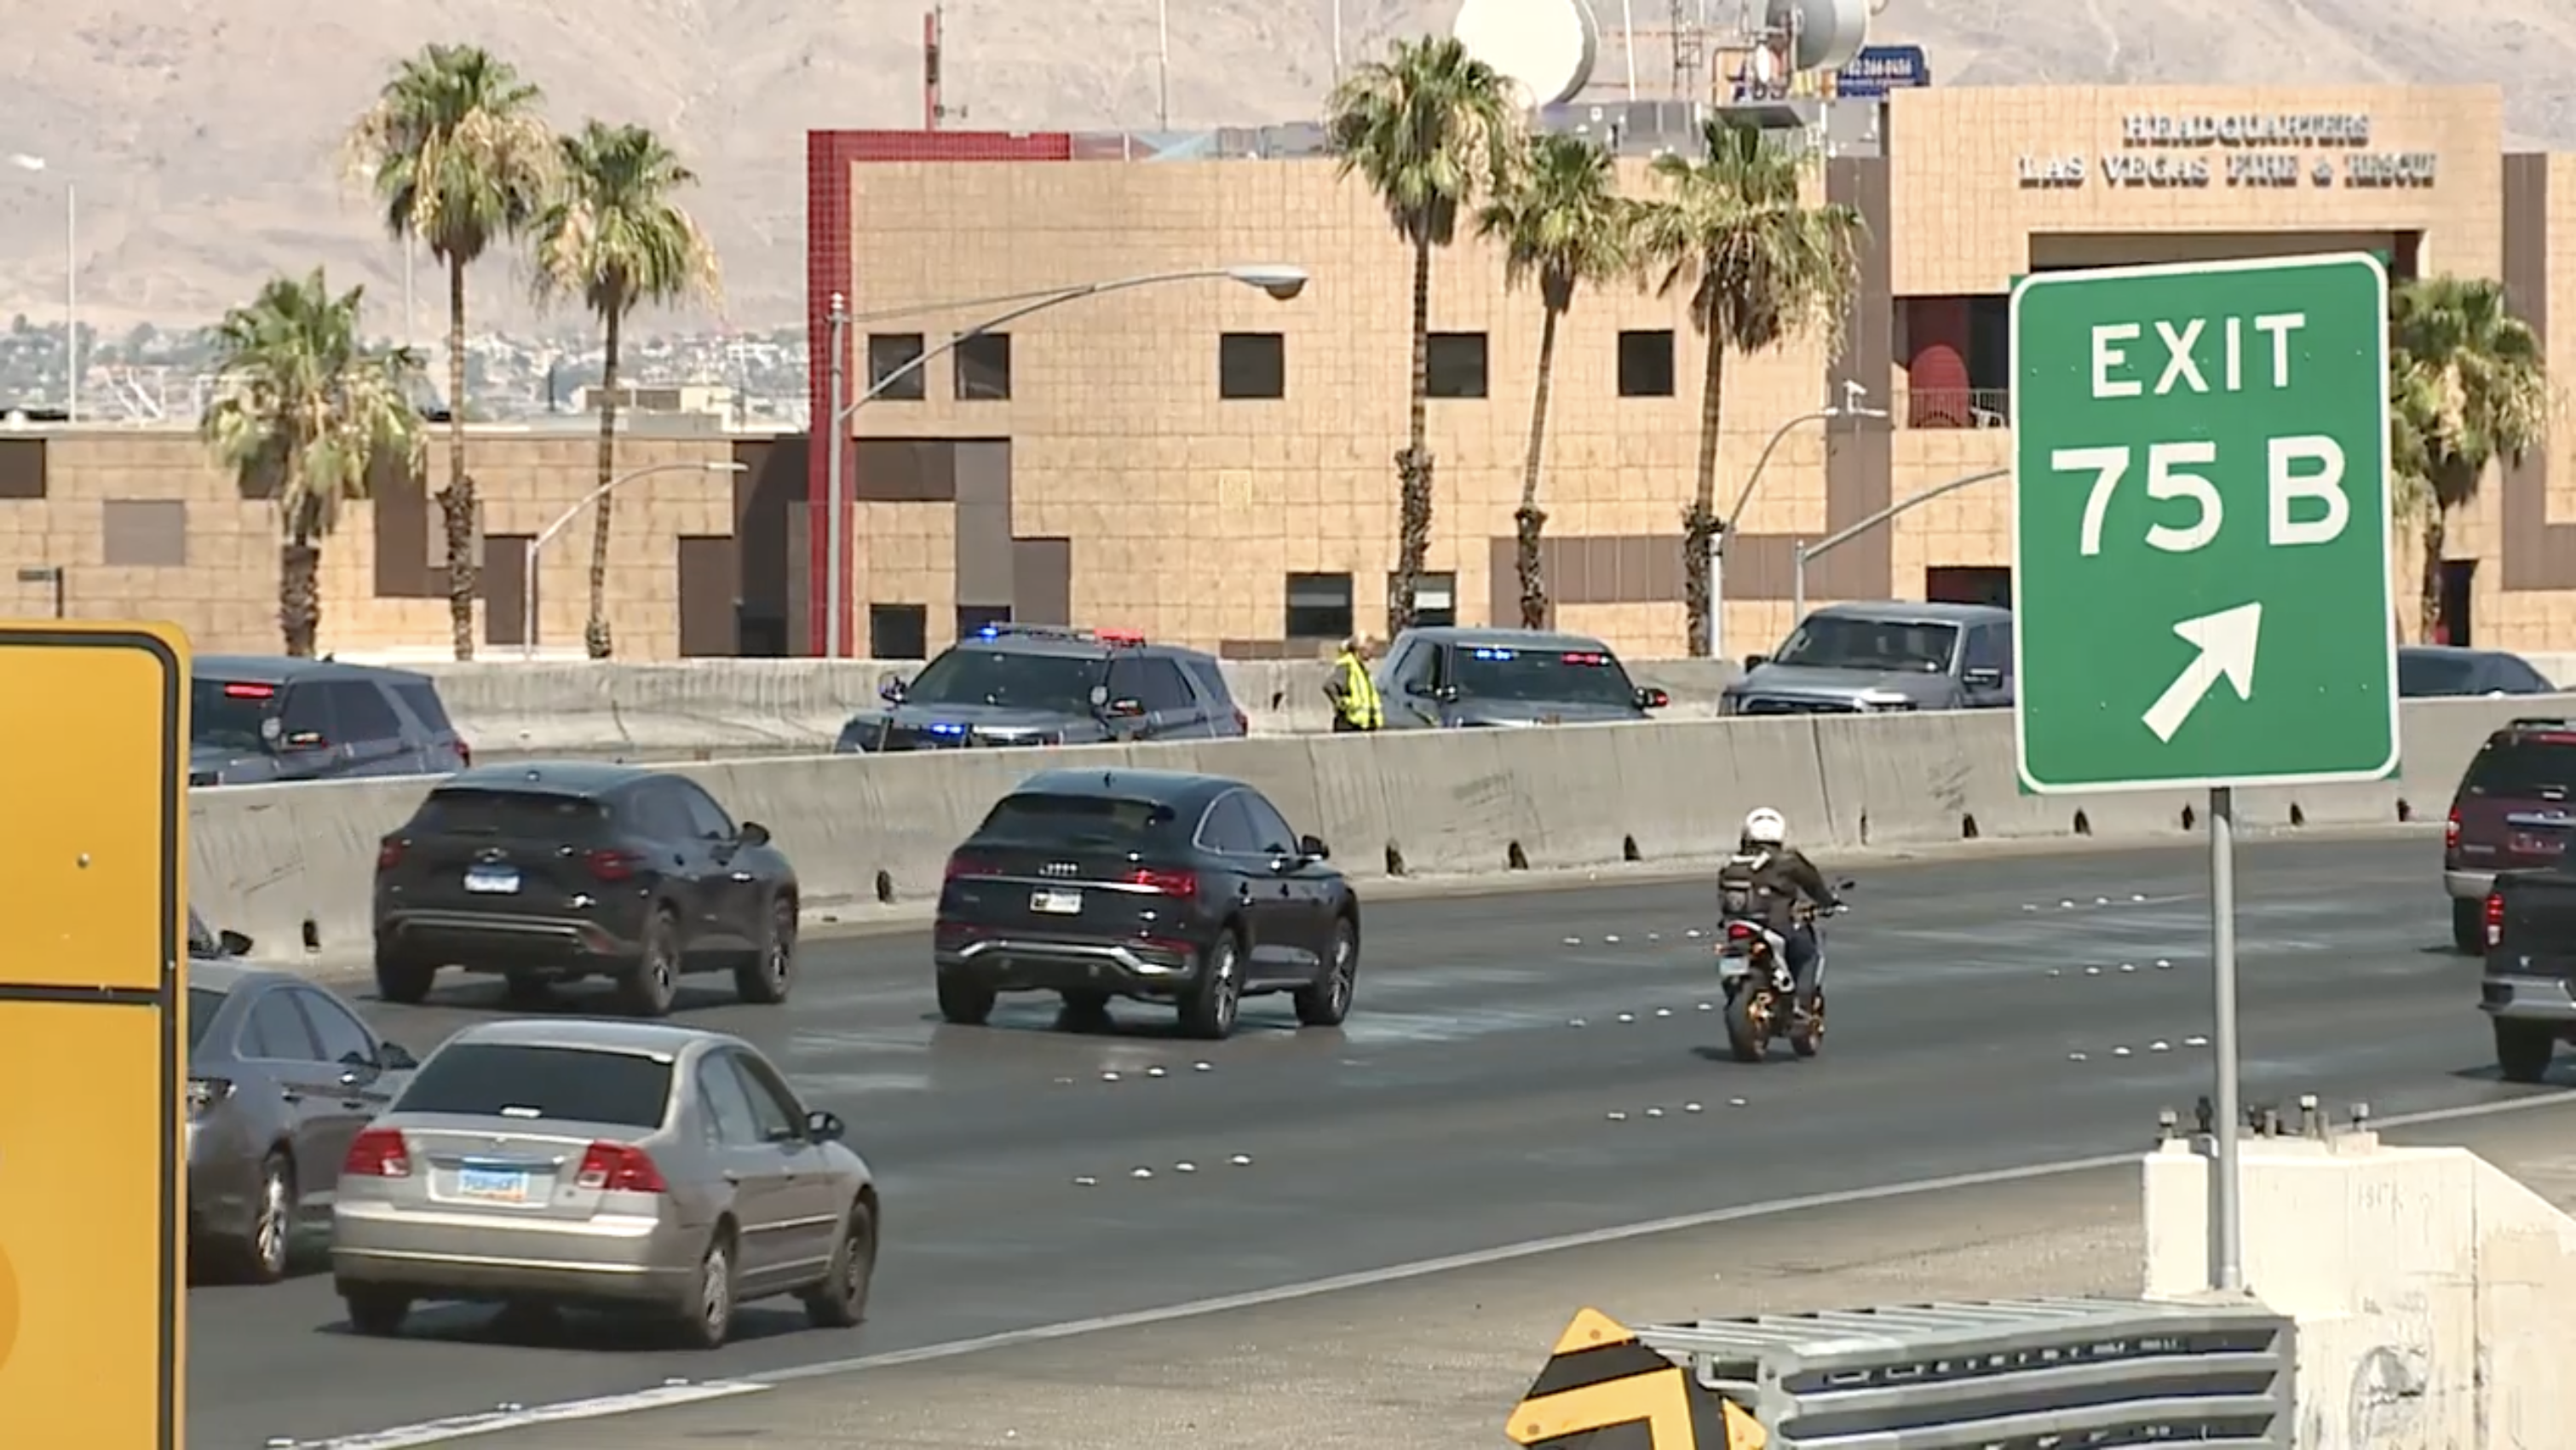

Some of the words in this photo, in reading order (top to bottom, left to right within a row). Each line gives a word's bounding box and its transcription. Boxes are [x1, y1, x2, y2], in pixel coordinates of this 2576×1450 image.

[2123, 114, 2369, 147] HEADQUARTERS
[2020, 156, 2084, 187] LAS
[2101, 155, 2210, 187] VEGAS
[2091, 312, 2306, 398] EXIT
[2051, 440, 2223, 556] 75
[2267, 434, 2350, 546] B
